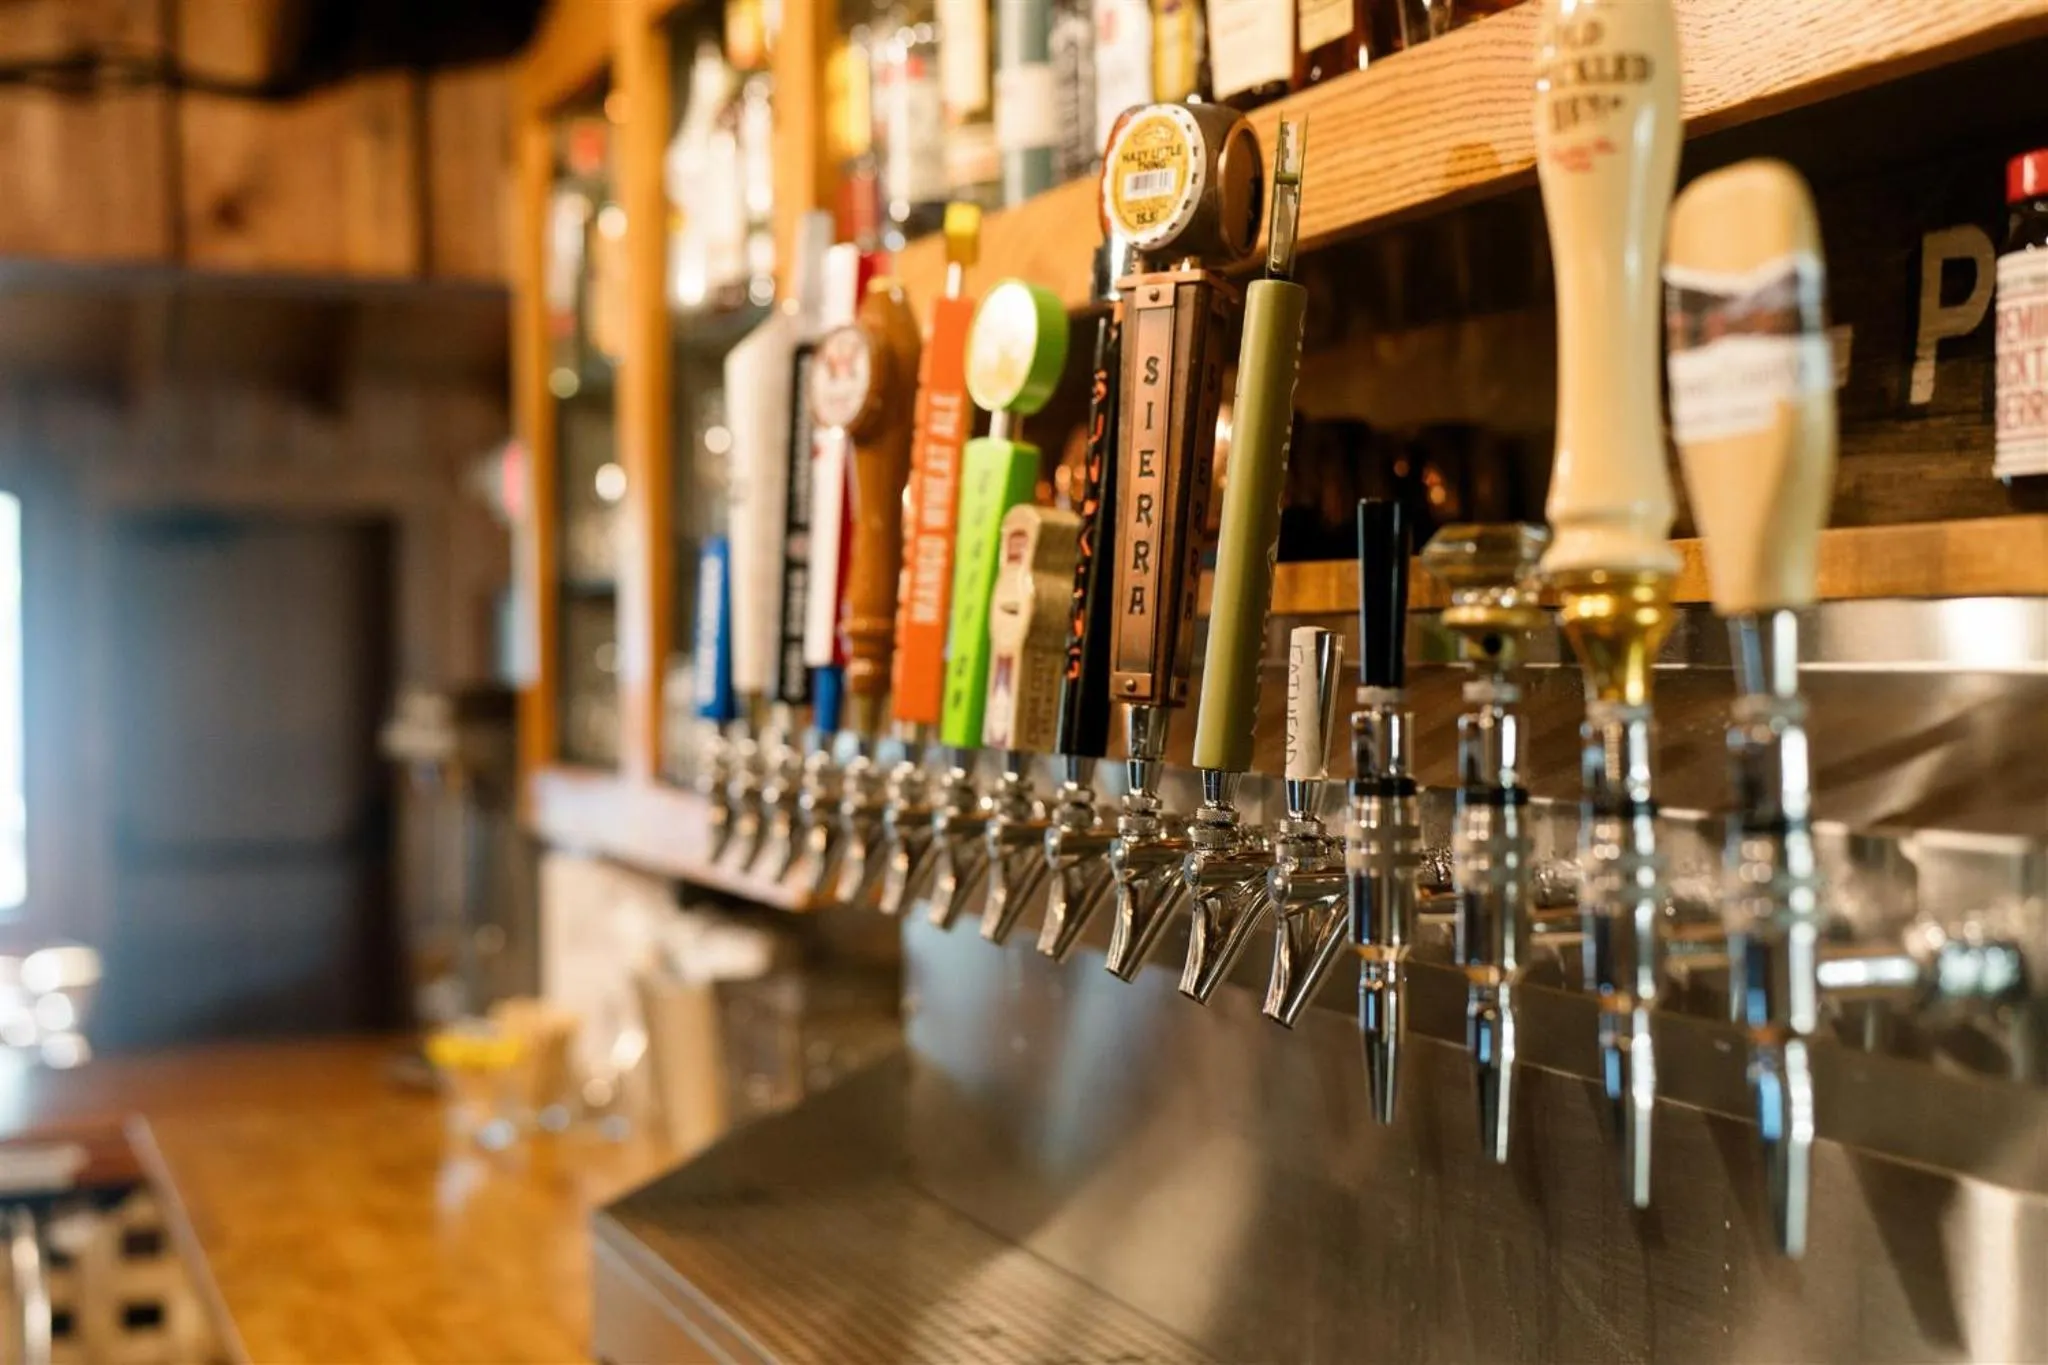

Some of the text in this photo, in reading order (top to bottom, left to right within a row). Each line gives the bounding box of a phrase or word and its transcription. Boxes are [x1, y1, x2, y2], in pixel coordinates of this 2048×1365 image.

[1122, 146, 1182, 163] HAZY LITTLE
[928, 391, 962, 439] ALE
[1128, 355, 1160, 616] SIERRA
[912, 534, 946, 623] MANGO
